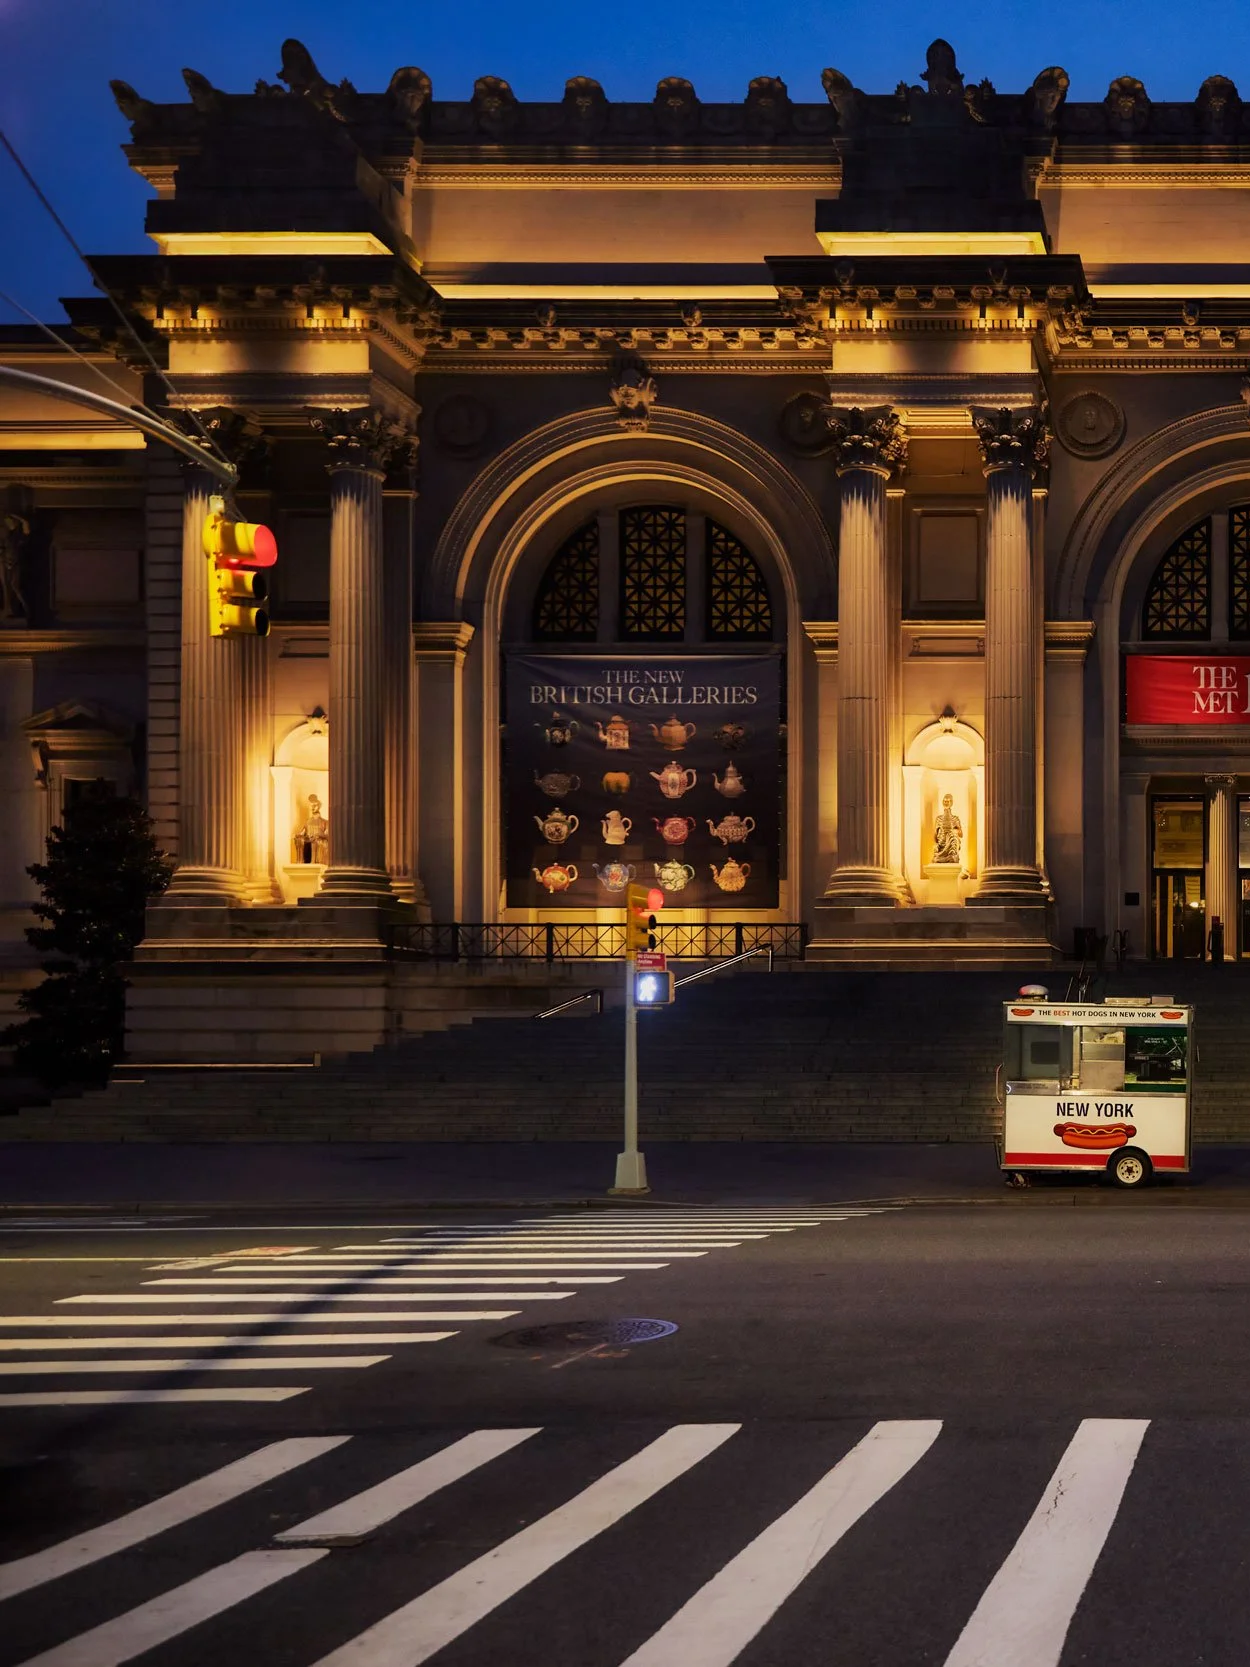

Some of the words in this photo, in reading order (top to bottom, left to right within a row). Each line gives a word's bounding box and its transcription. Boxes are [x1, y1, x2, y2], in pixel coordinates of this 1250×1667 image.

[602, 670, 639, 684] THE
[644, 670, 685, 684] NEW
[1192, 666, 1238, 689] THE
[530, 686, 622, 704] BRITISH
[628, 686, 758, 705] GALLERIES
[1191, 690, 1239, 714] MET
[1056, 1102, 1089, 1117] NEW
[1094, 1103, 1134, 1118] YORK
